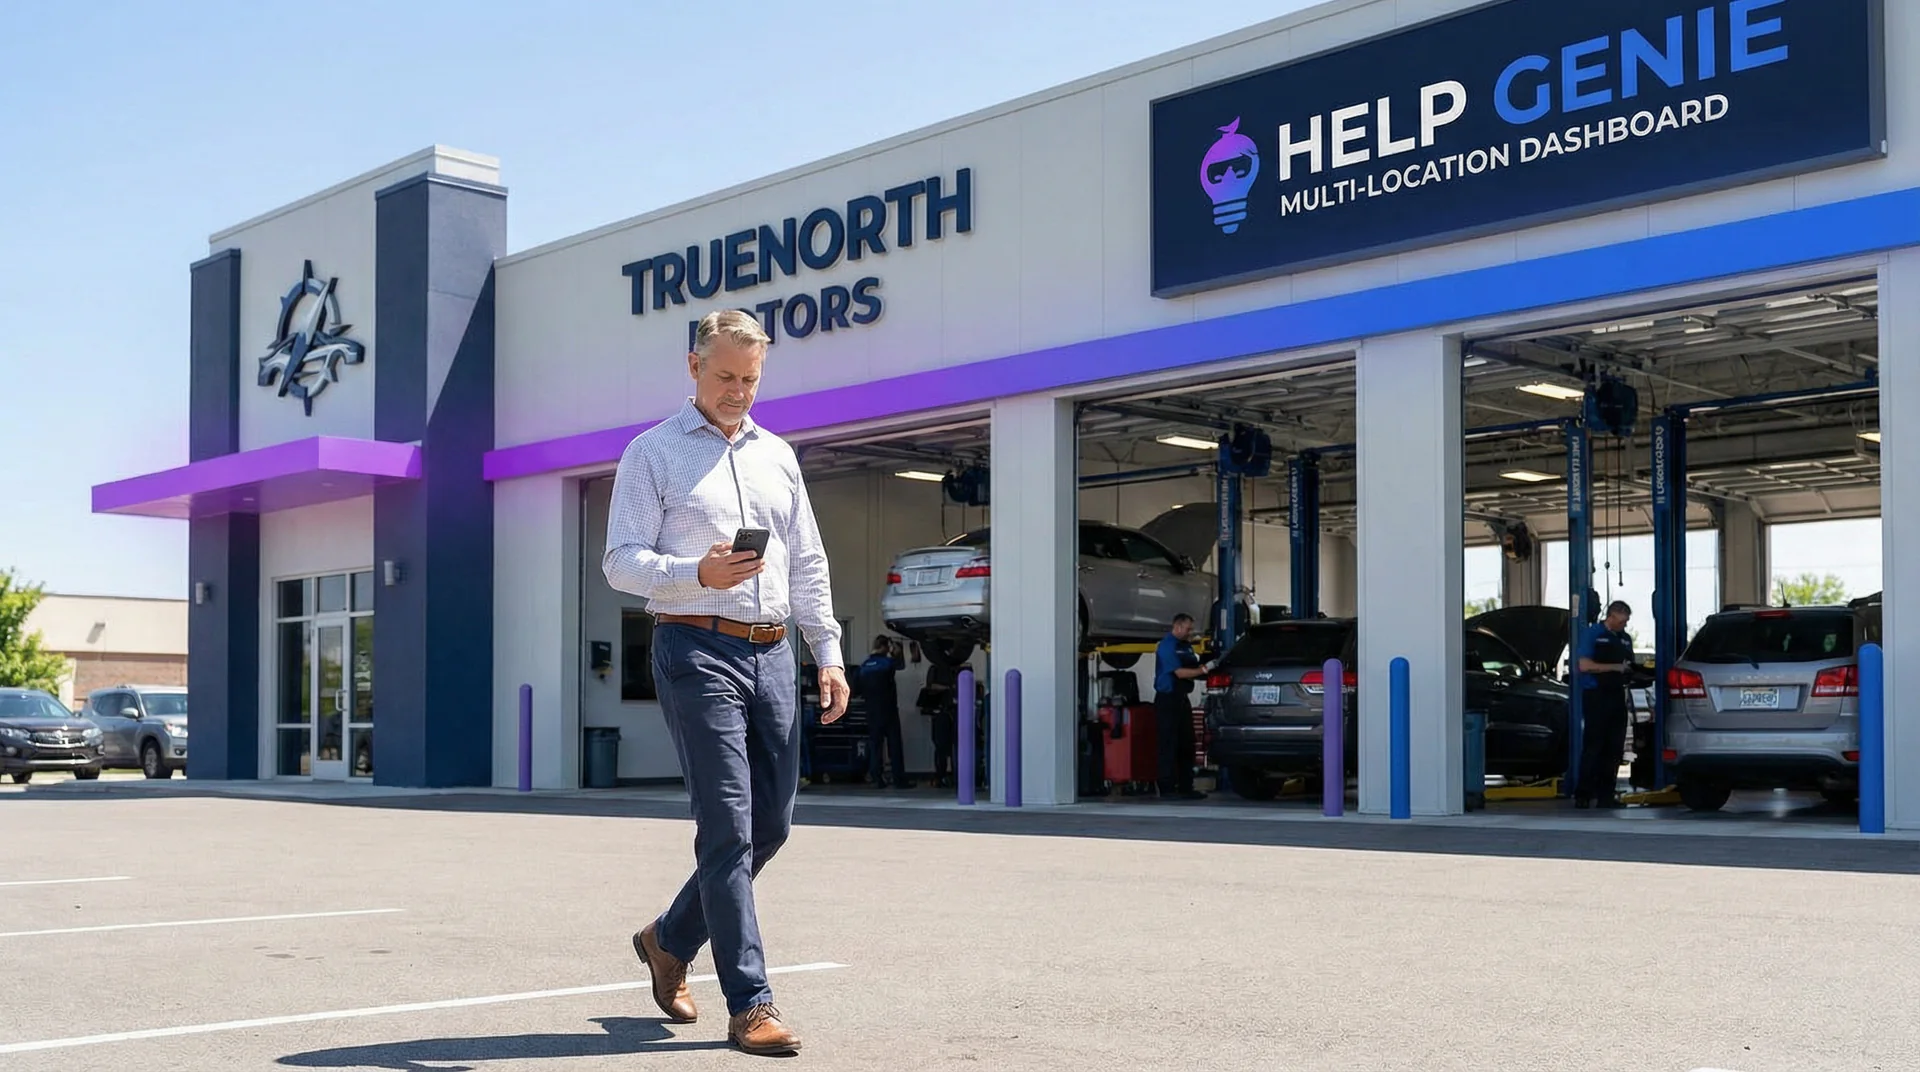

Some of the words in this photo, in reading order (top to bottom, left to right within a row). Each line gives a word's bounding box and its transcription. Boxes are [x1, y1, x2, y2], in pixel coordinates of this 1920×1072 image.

[1278, 80, 1467, 181] HELP
[1493, 0, 1789, 124] GENIE
[1280, 140, 1510, 217] MULTI-LOCATION
[1520, 94, 1729, 163] DASHBOARD
[622, 167, 972, 316] TRUENORTH
[688, 276, 883, 352] TORS
